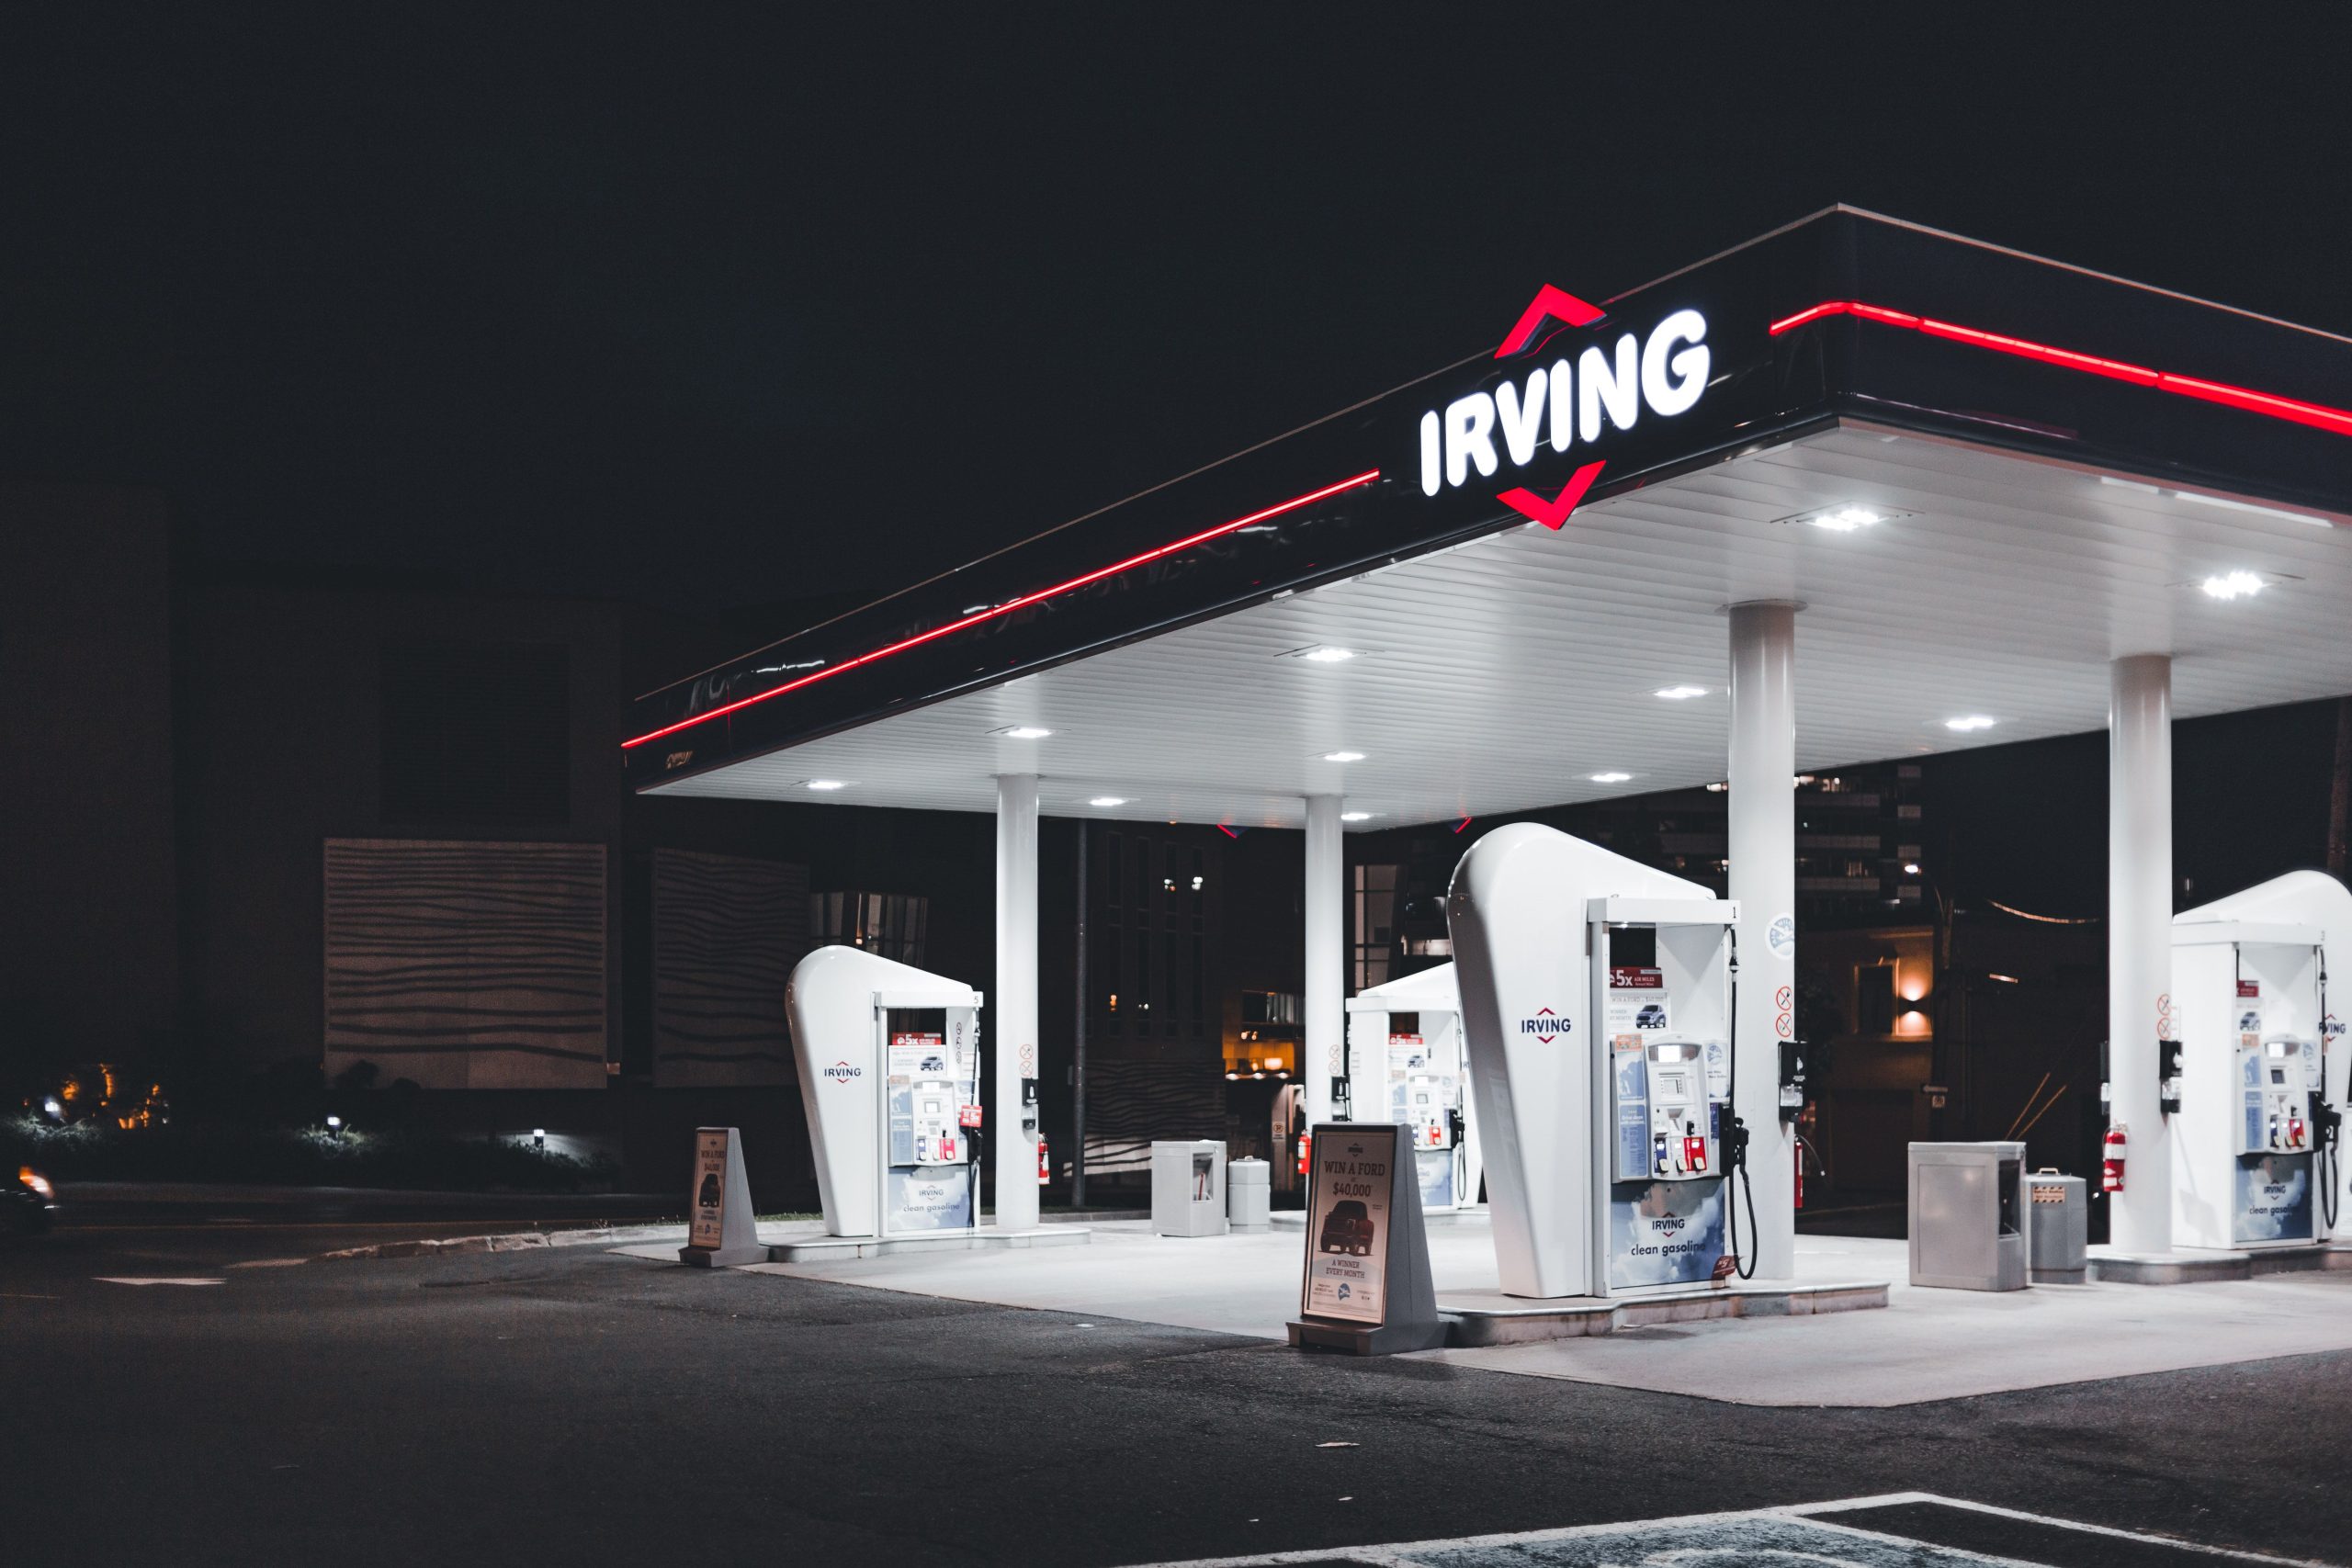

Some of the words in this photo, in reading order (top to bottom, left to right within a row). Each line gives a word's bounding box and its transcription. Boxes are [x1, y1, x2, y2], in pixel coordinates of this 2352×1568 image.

[1419, 309, 1711, 497] IRVING
[1733, 906, 1736, 919] 1
[1616, 969, 1633, 987] 5x
[974, 996, 979, 1004] 5
[1521, 1018, 1571, 1033] IRVING
[2318, 1021, 2346, 1034] RVING
[905, 1033, 919, 1045] 5x
[824, 1067, 861, 1077] IRVING
[1324, 1160, 1346, 1174] WIN
[1349, 1162, 1355, 1175] A
[1358, 1162, 1385, 1177] FORD
[1332, 1181, 1372, 1198] $40,000
[2264, 1185, 2286, 1194] IRVING
[903, 1204, 924, 1213] clean
[927, 1202, 960, 1213] gasoline
[2249, 1205, 2267, 1214] clean
[1652, 1218, 1685, 1230] IRVING
[1631, 1244, 1658, 1256] clean
[1662, 1240, 1706, 1257] gasoline
[1338, 1259, 1360, 1269] WINNER
[1326, 1267, 1343, 1276] EVERY
[1344, 1269, 1365, 1279] MONTH
